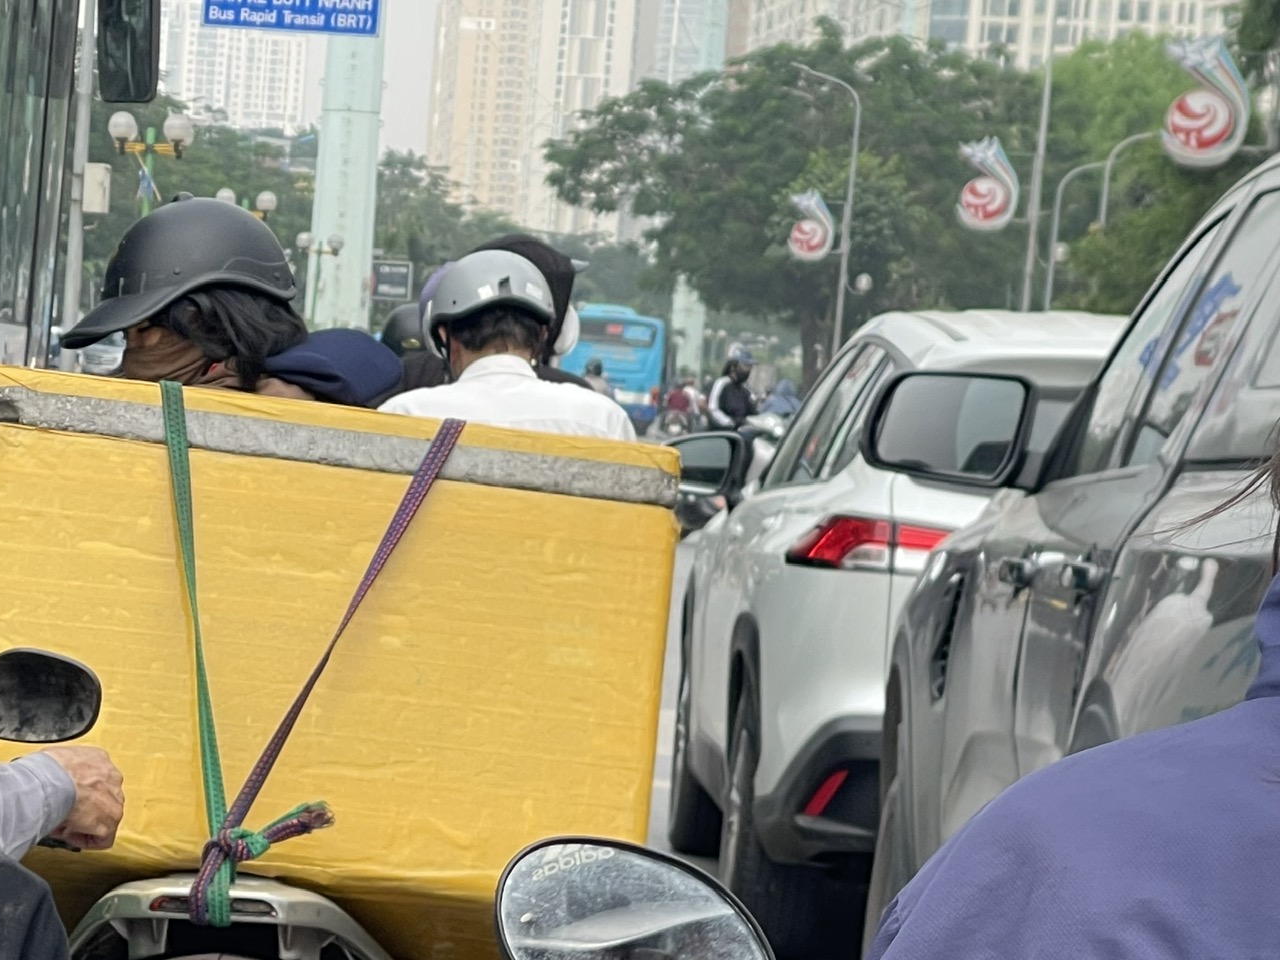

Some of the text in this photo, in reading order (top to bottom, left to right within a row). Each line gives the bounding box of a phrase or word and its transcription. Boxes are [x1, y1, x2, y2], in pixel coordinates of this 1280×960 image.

[208, 5, 373, 31] Bus Rapid Transit (BRT)
